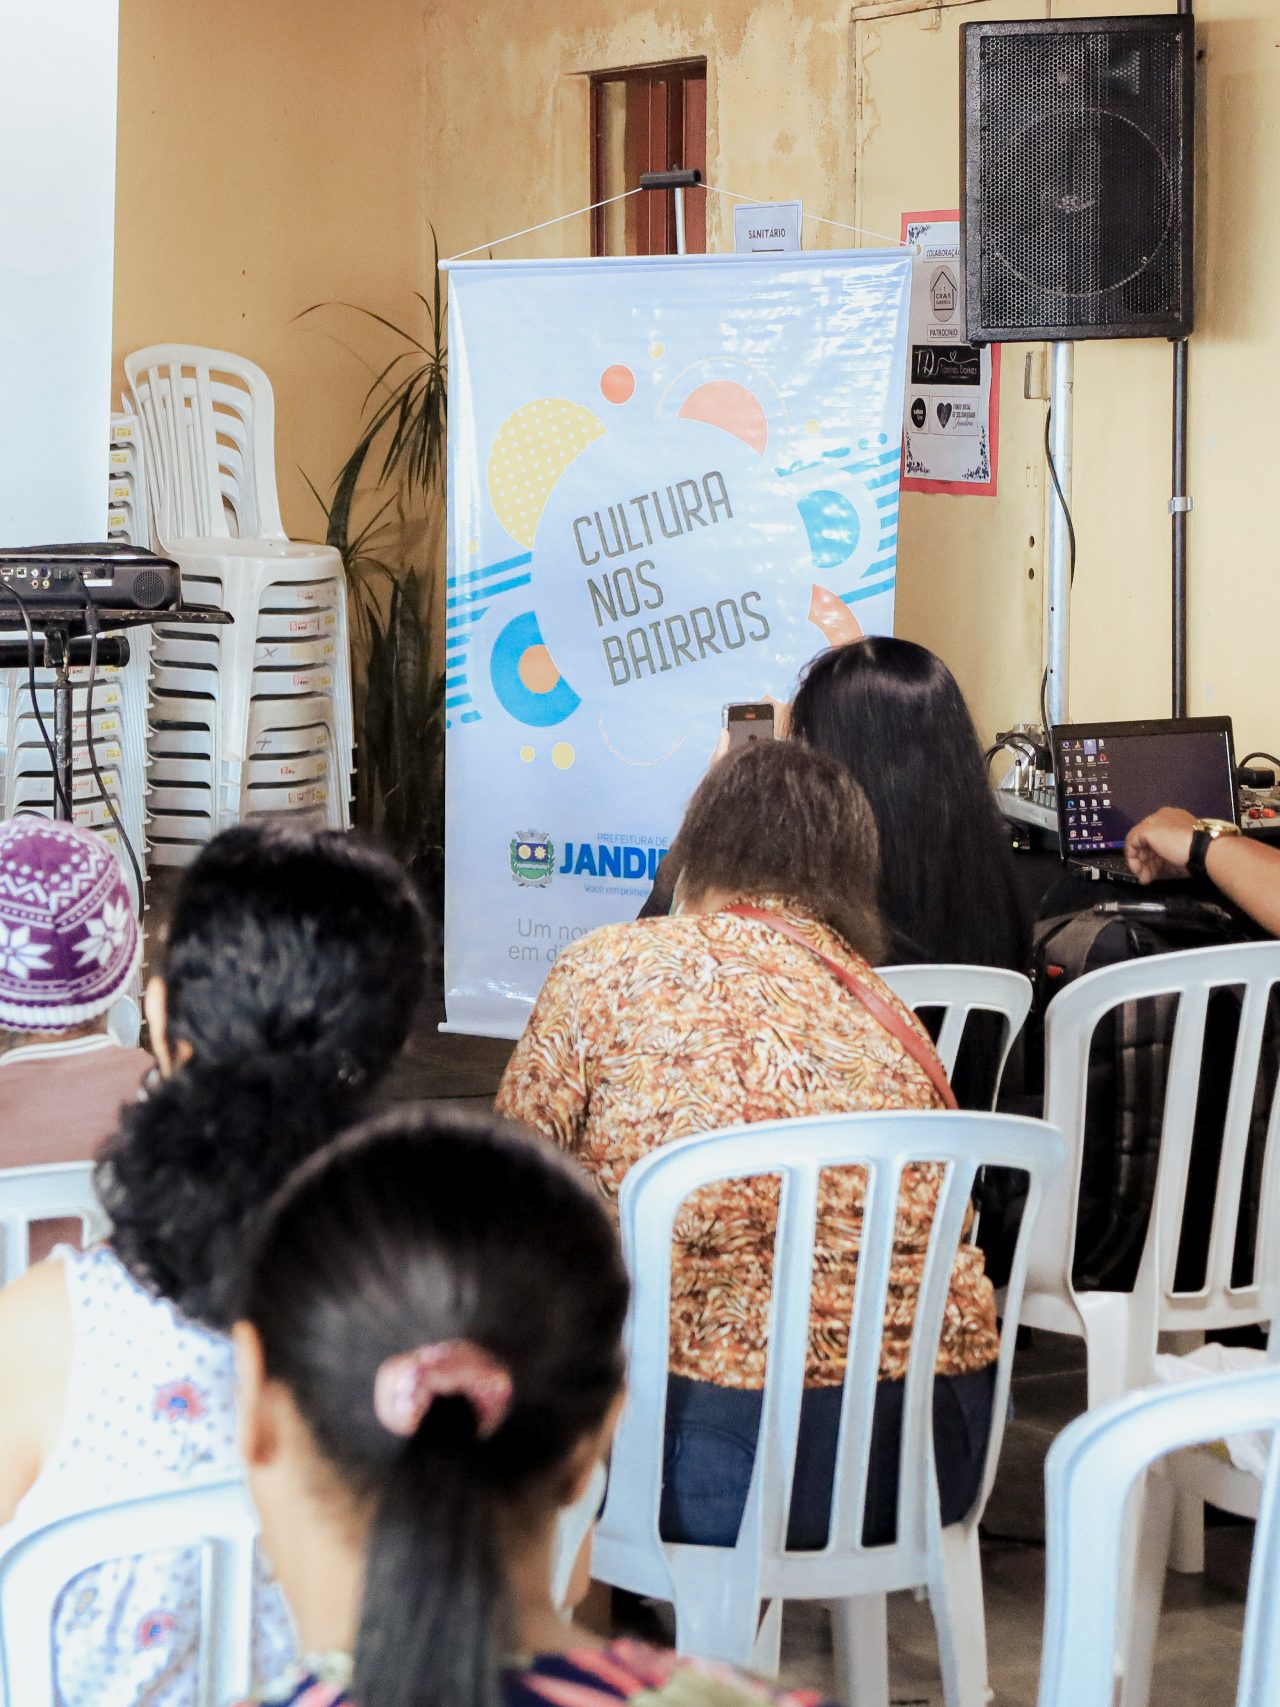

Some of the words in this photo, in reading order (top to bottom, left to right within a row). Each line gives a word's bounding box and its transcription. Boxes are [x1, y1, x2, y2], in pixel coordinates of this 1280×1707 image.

[572, 470, 733, 566] CULTURA
[587, 559, 664, 627] NOS
[602, 591, 770, 687] BAIRROS
[597, 832, 654, 846] PREFEITURA
[655, 836, 668, 847] DE
[620, 887, 651, 898] primeir
[518, 918, 551, 939] Um
[508, 945, 539, 961] em
